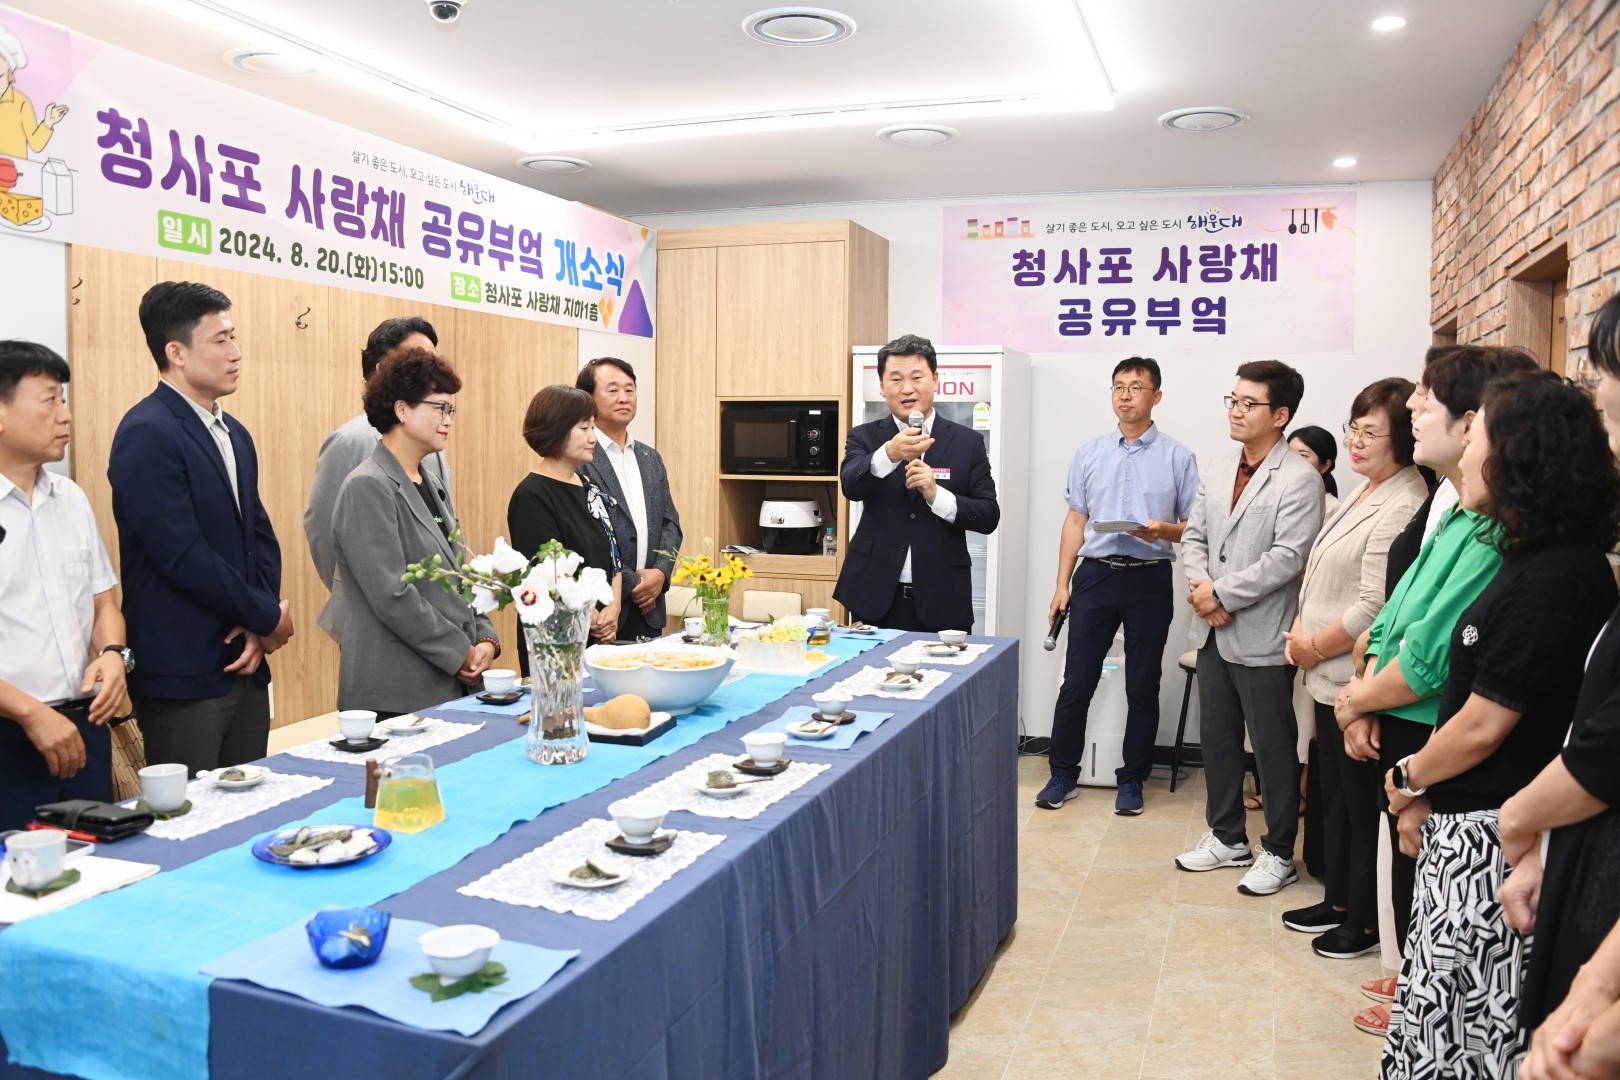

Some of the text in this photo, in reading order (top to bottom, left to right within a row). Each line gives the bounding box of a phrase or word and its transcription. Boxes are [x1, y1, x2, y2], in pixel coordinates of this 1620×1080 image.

[352, 150, 495, 205] 살기 좋은 도시, 오고 싶은 도시 해운대
[96, 107, 625, 297] 청사포 사랑채 공유부엌 개소식
[1045, 214, 1243, 234] 살기 좋은 도시, 오고 싶은 도시 해운대
[162, 215, 208, 249] 일시
[219, 227, 282, 264] 2024.
[290, 242, 309, 269] 8.
[1012, 242, 1278, 287] 청사포 사랑채
[453, 275, 599, 322] 장소 청사포 사랑채 지하1층
[1057, 295, 1228, 337] 공유부엌
[937, 381, 974, 395] ION
